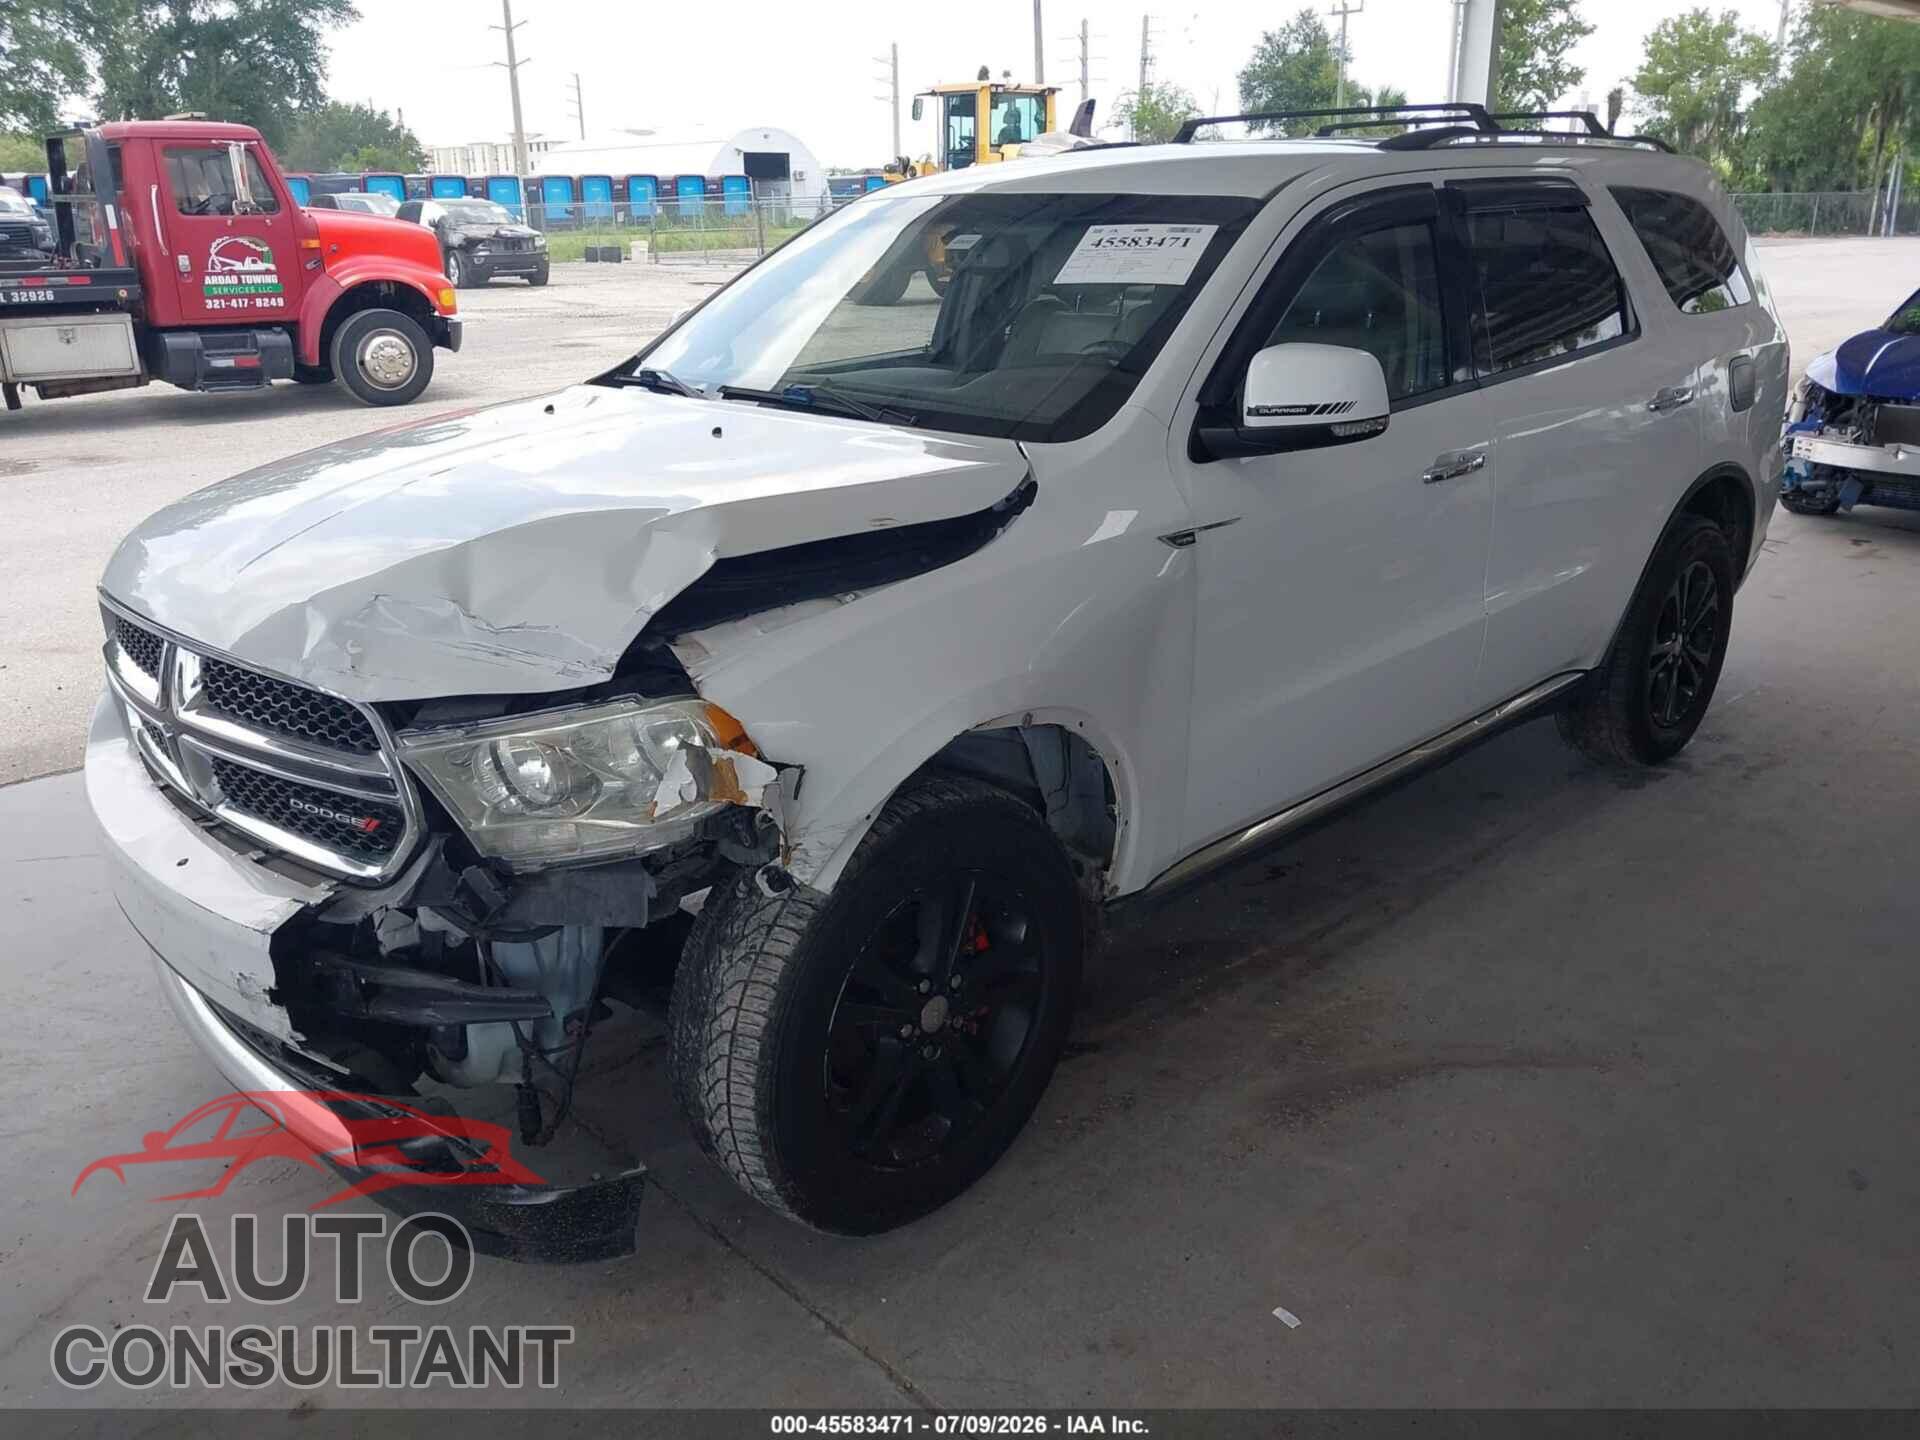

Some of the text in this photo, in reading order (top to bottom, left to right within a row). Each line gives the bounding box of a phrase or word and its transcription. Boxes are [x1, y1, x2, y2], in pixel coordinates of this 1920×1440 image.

[1090, 236, 1191, 248] 45583471
[241, 274, 278, 284] TOWING
[11, 290, 55, 303] 32926
[212, 286, 256, 295] SERVICES
[290, 798, 367, 829] DODGE
